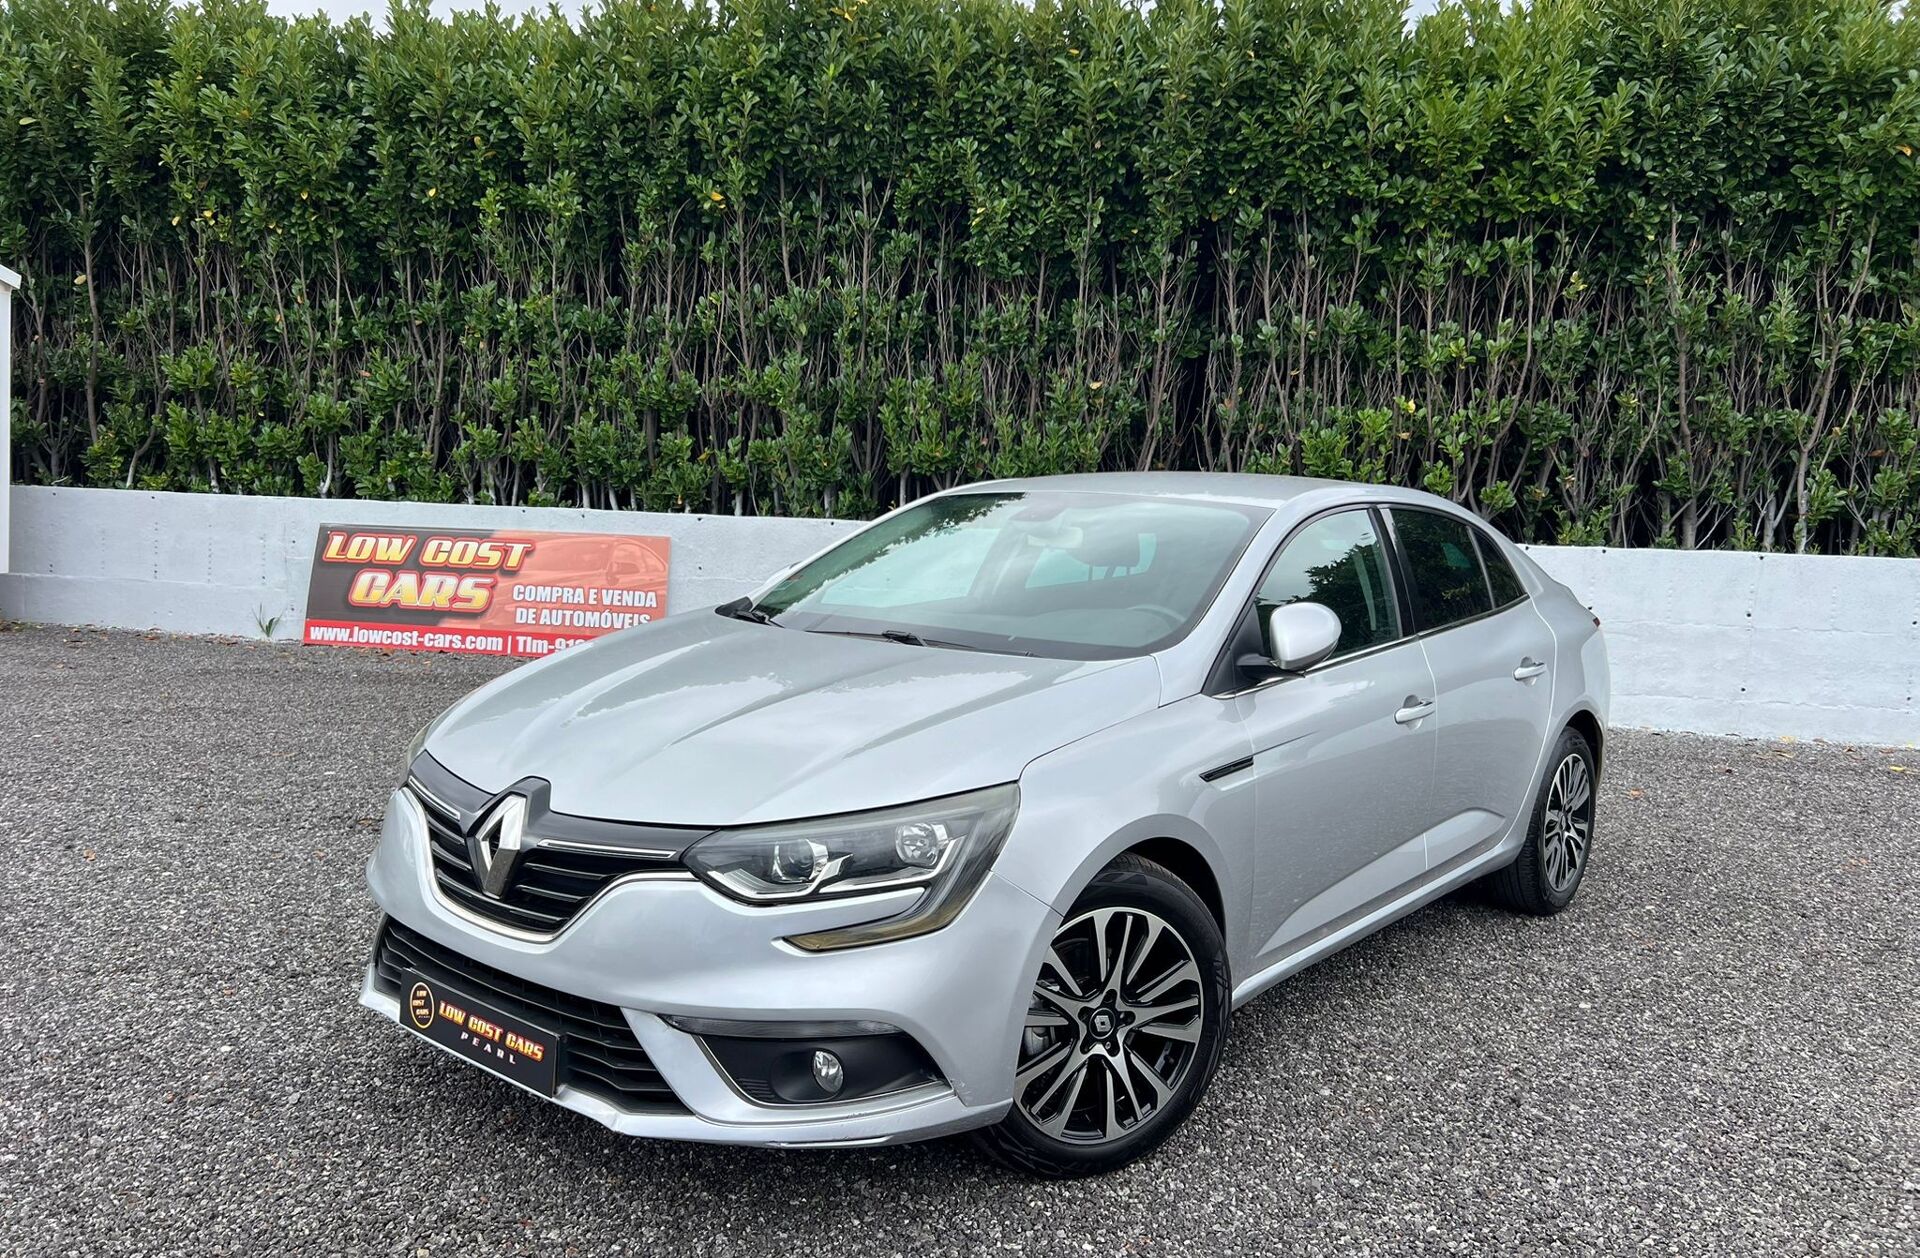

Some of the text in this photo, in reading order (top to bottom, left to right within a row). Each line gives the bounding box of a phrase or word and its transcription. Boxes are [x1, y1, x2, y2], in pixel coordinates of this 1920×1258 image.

[324, 533, 534, 570] LOW COST
[351, 570, 498, 612] CARS
[513, 584, 658, 608] COMPRA E VENDA
[515, 607, 536, 624] DE
[309, 625, 503, 652] www.lowcost-cars.com
[439, 1001, 545, 1062] LOW COST CARS
[460, 1032, 517, 1065] PEARL
